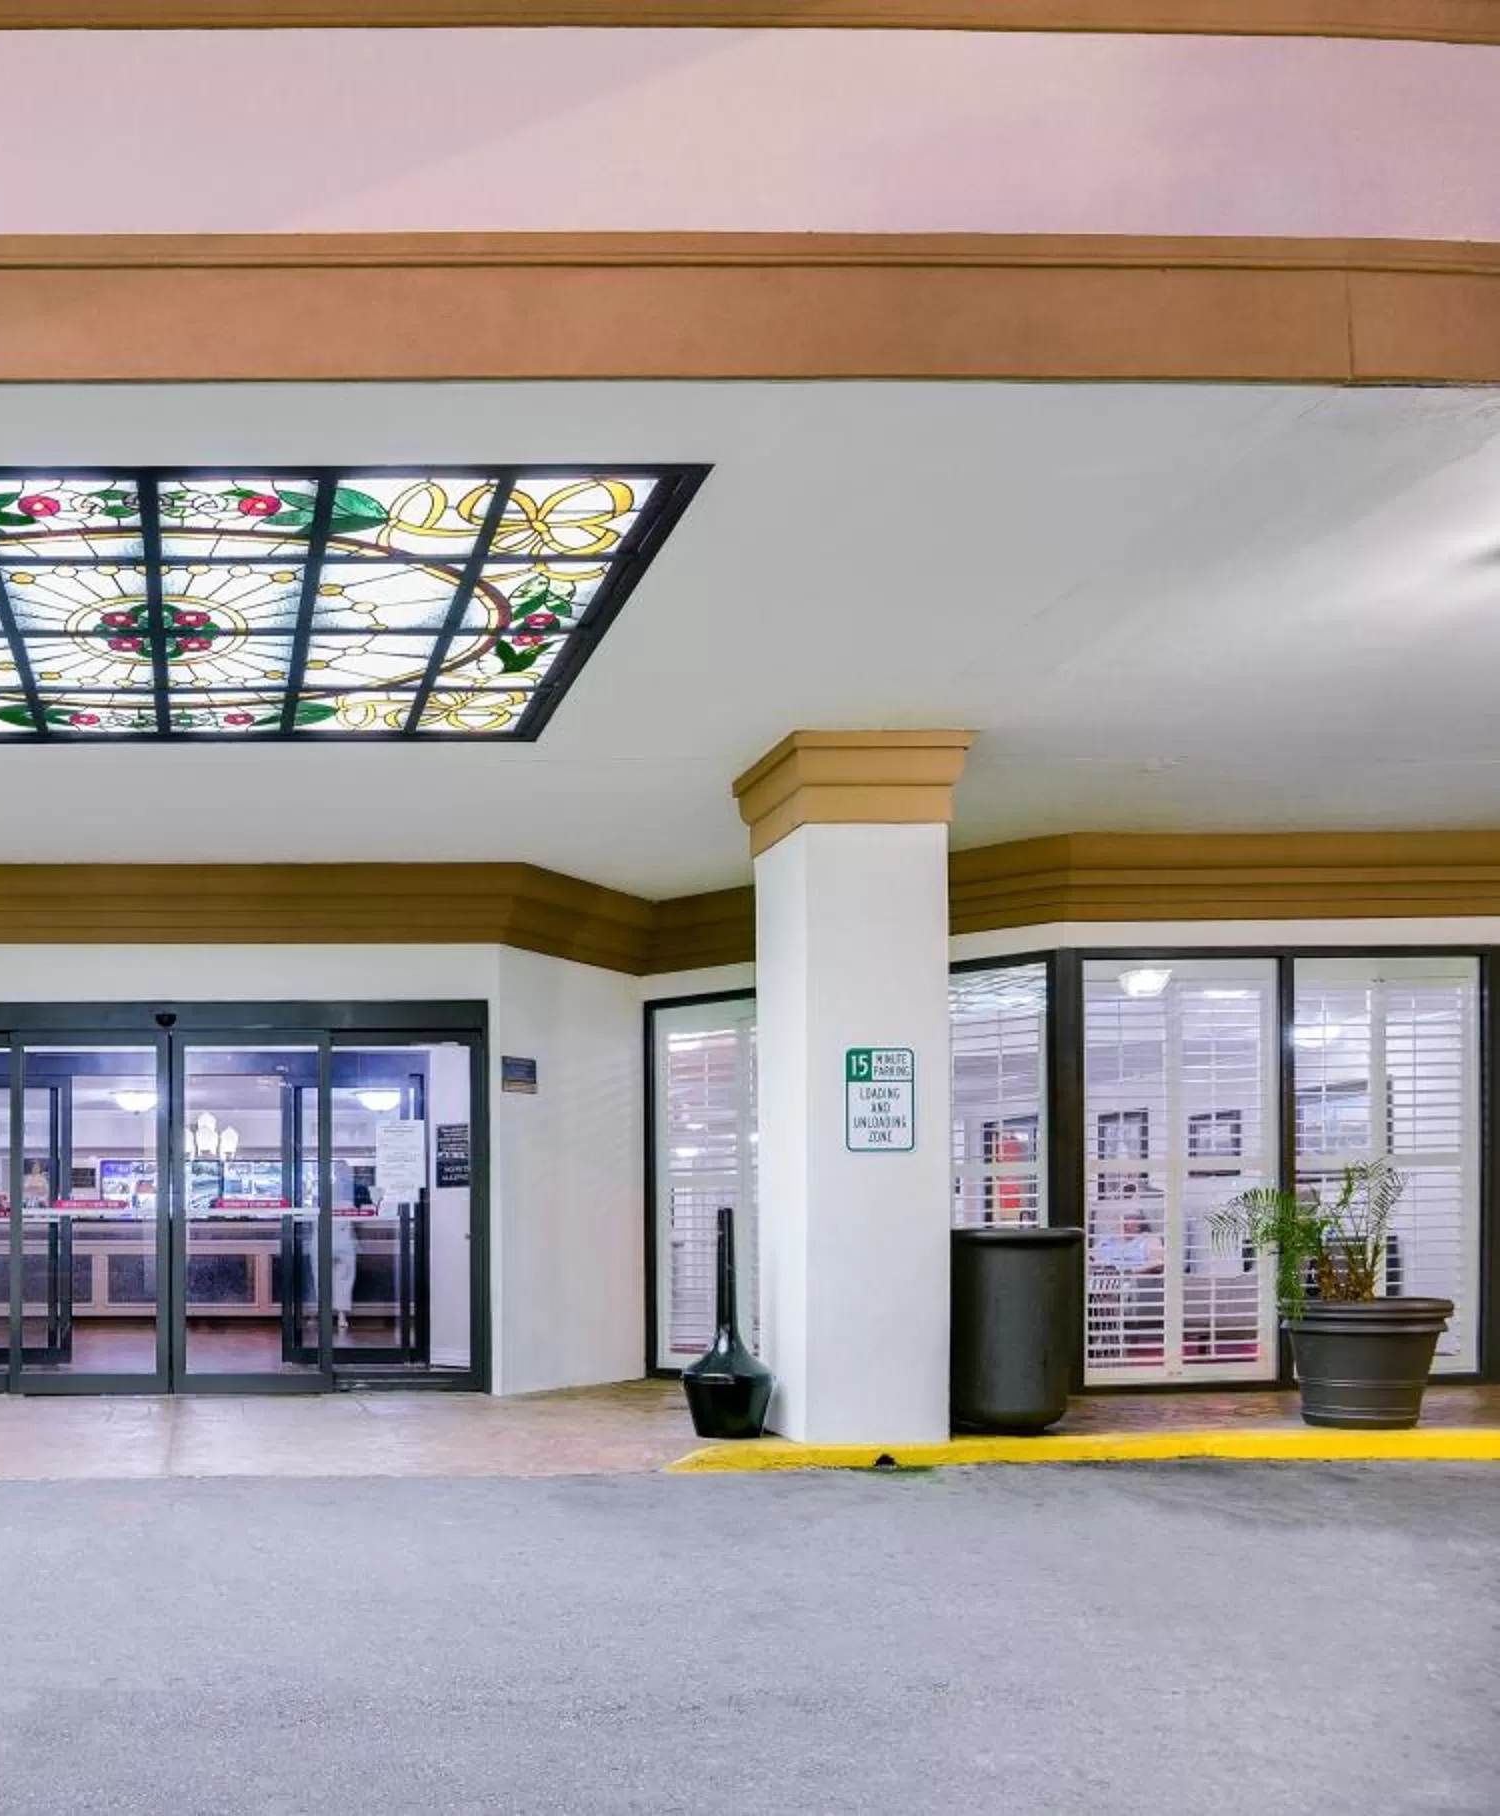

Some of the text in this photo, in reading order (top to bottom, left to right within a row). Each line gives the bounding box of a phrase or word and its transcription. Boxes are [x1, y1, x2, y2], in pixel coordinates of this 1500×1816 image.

[851, 1055, 868, 1076] 15
[860, 1088, 900, 1100] LOADING
[871, 1102, 890, 1112] AND
[854, 1116, 906, 1128] UNLOADING
[868, 1131, 892, 1142] ZONE
